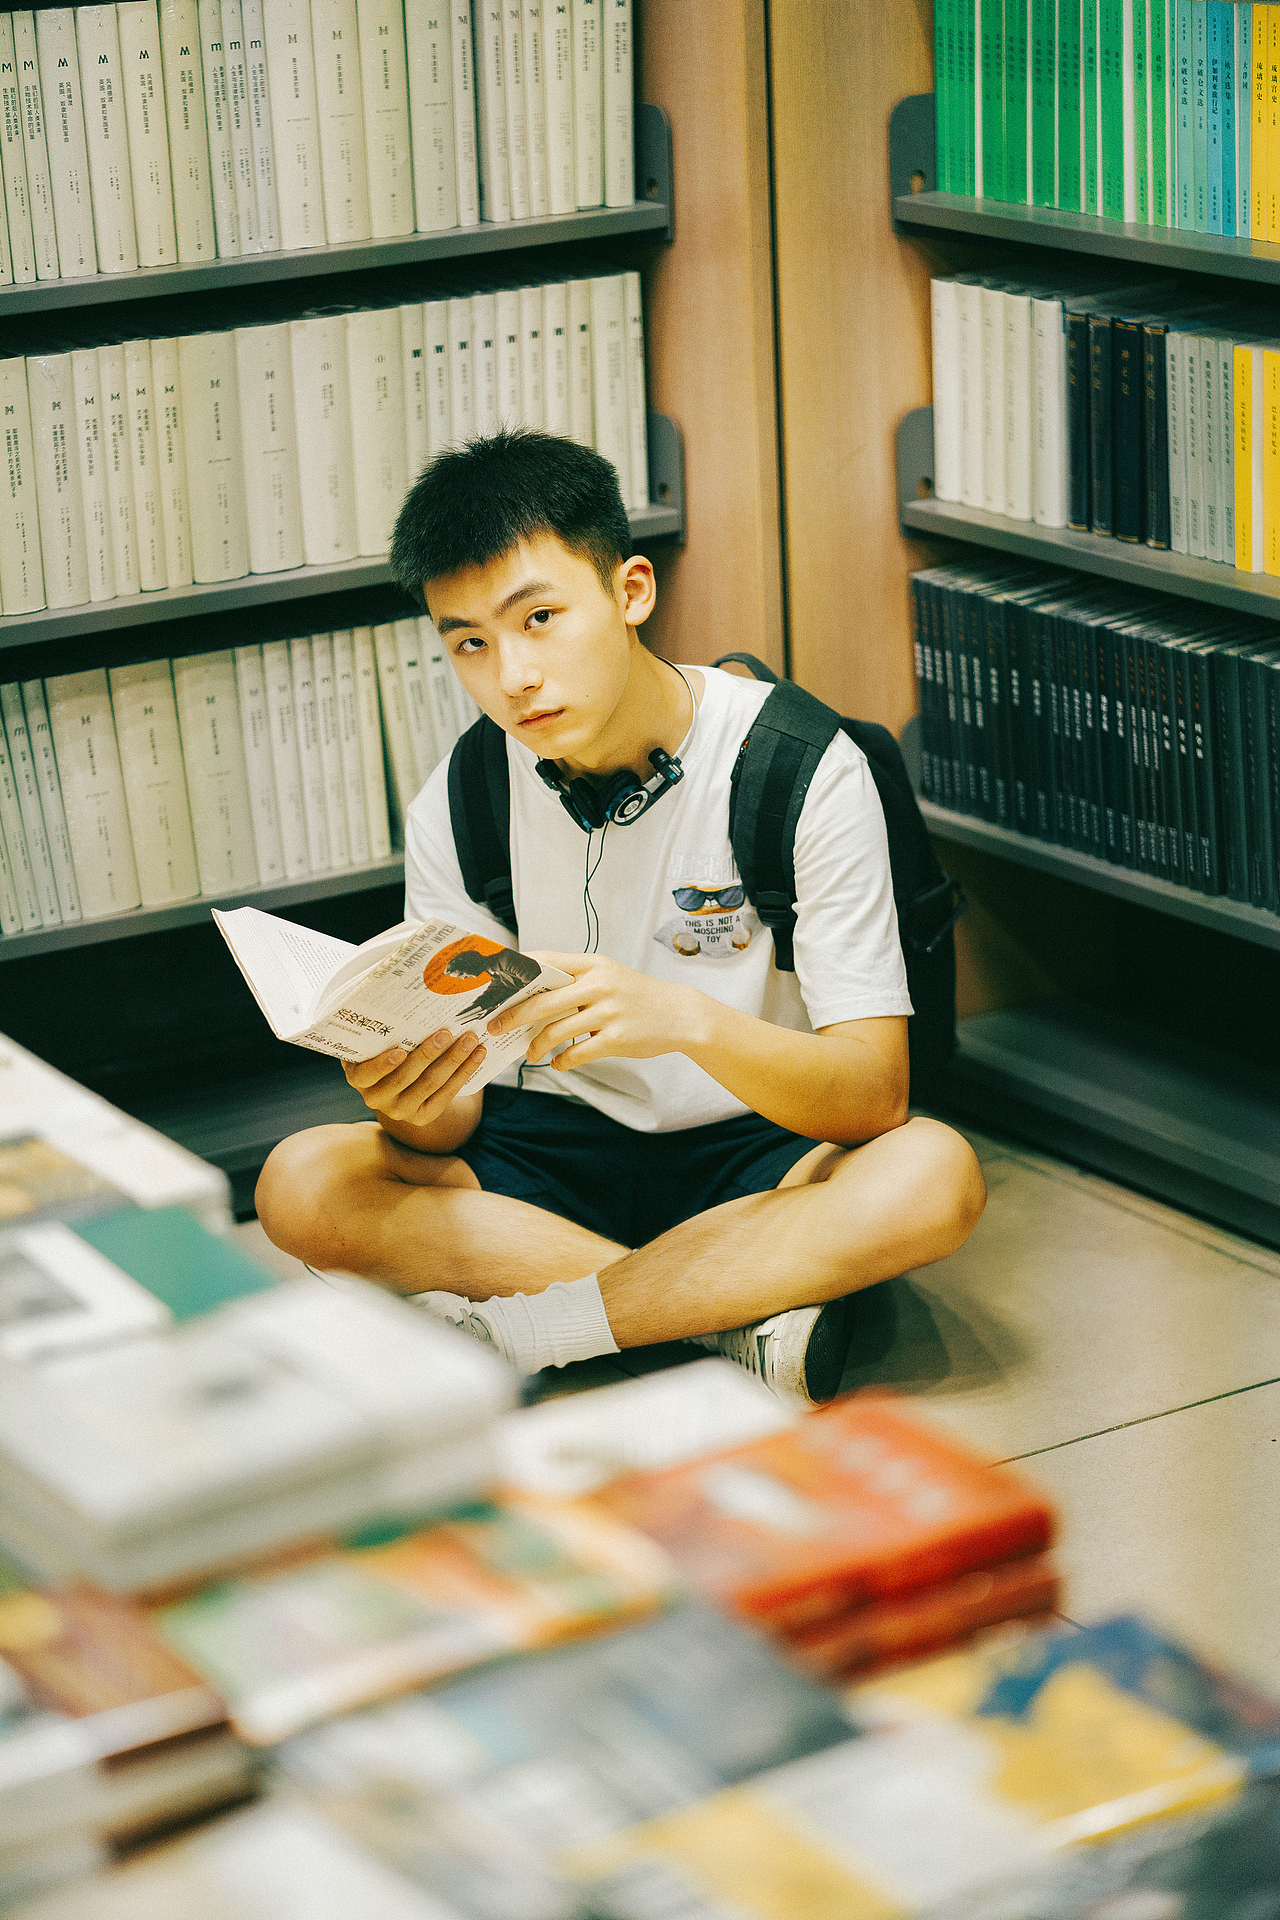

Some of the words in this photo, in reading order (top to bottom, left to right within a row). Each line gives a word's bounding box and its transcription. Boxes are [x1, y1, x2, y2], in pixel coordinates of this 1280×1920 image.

[2, 62, 12, 73] M
[23, 60, 34, 71] M
[718, 916, 733, 925] NOT
[694, 924, 734, 934] MOSCHINO
[392, 968, 406, 977] IN
[431, 924, 456, 944] HOTEL
[333, 1006, 394, 1036] 流放者归来
[304, 1032, 332, 1046] Exile's
[330, 1042, 358, 1056] Return
